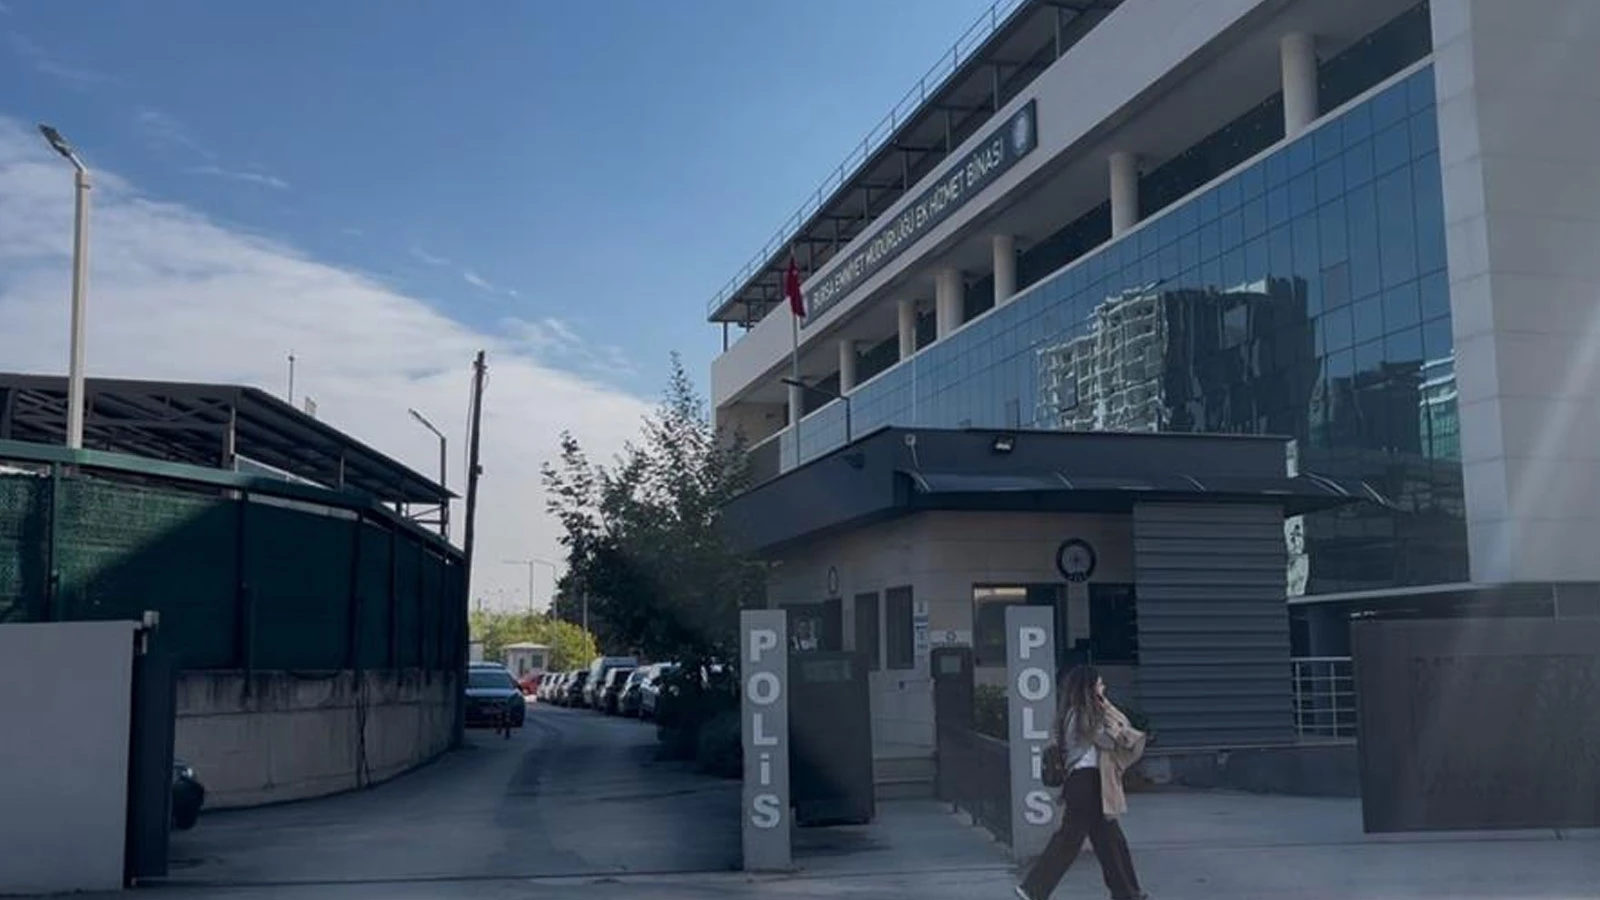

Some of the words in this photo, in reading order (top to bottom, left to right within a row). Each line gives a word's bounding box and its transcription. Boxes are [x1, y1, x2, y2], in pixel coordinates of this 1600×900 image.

[813, 278, 834, 311] BURSA
[916, 201, 929, 228] EK
[929, 168, 965, 217] HİZMET
[966, 136, 1004, 188] BİNASI
